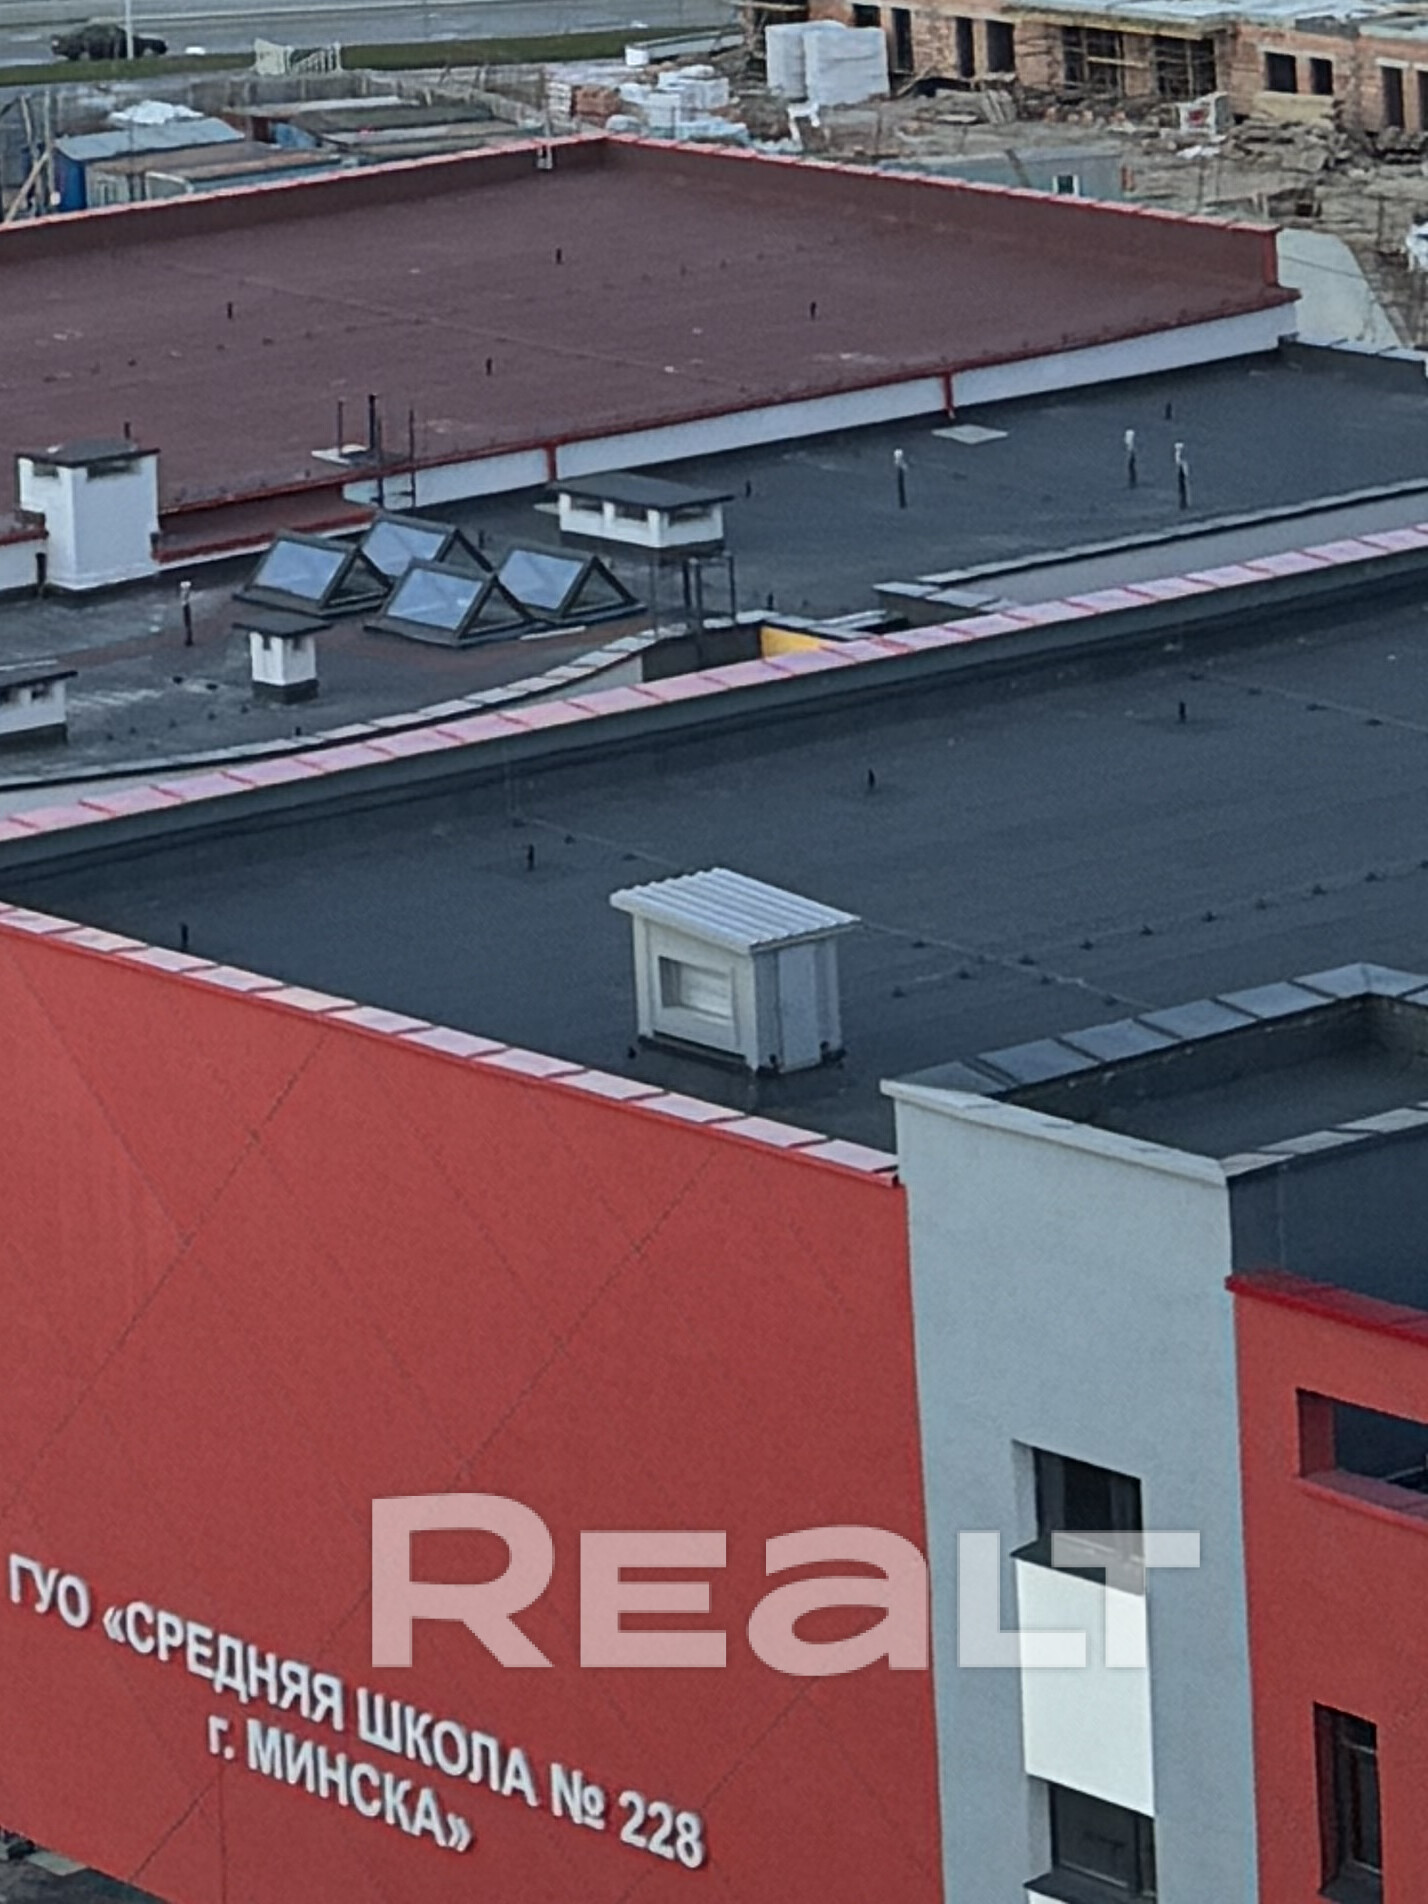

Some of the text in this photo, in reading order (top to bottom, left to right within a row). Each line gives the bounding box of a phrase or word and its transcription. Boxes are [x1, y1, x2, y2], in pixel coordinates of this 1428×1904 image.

[8, 1552, 704, 1868] ГУО «СРЕДНЯЯ ШКОЛА № 228
[207, 1714, 472, 1852] г. МИНСКА»
